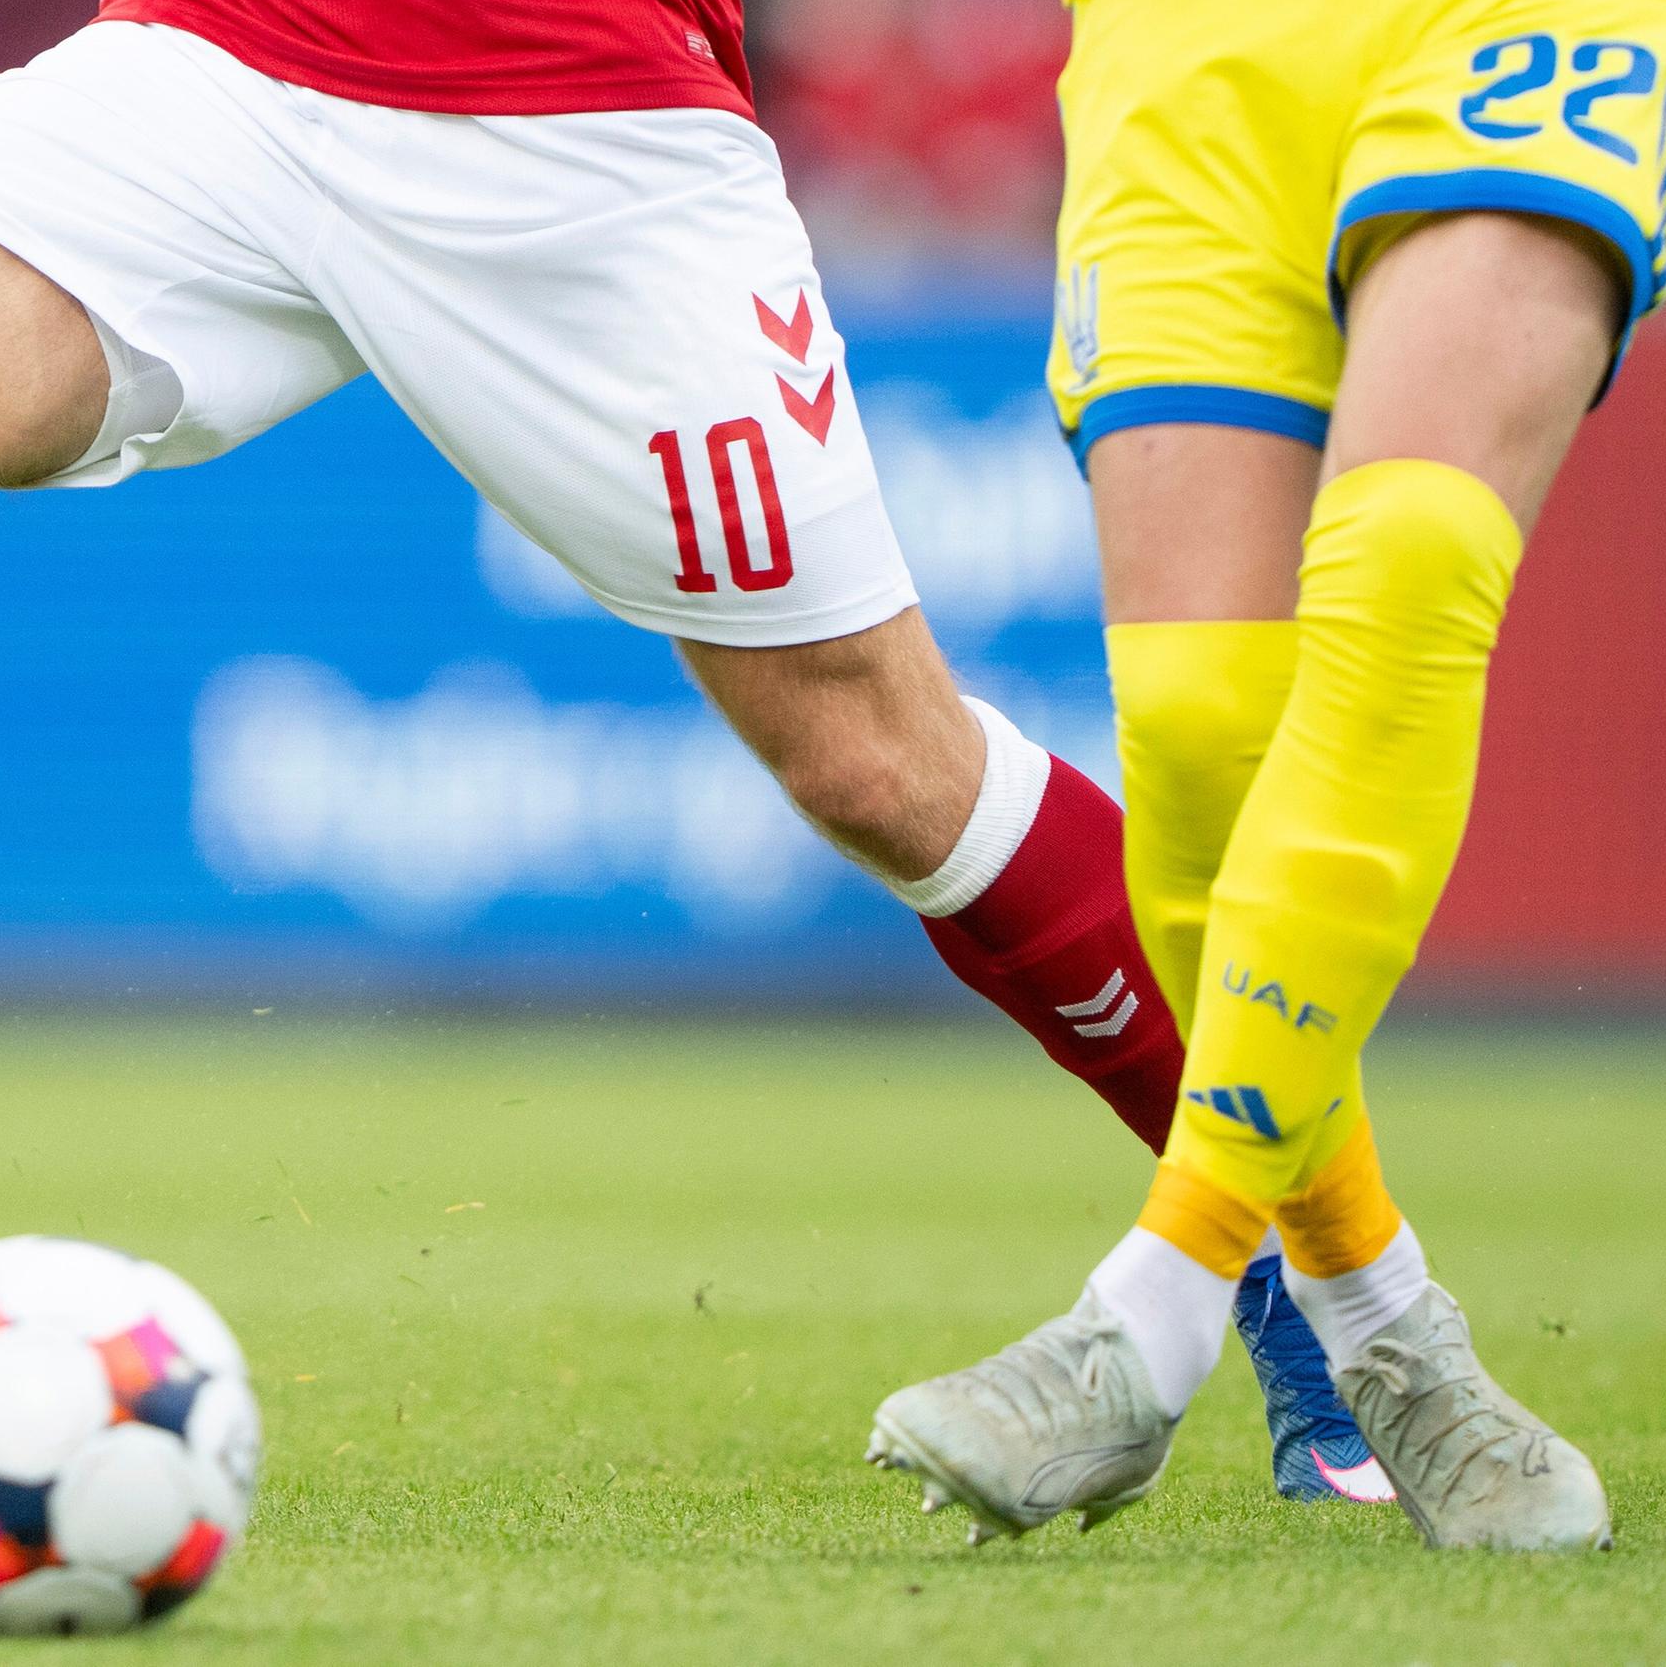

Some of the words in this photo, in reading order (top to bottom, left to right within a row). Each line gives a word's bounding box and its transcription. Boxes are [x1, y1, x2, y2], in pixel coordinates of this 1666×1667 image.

[1459, 32, 1657, 166] 22
[648, 415, 795, 594] 10
[1222, 958, 1339, 1035] UAF
